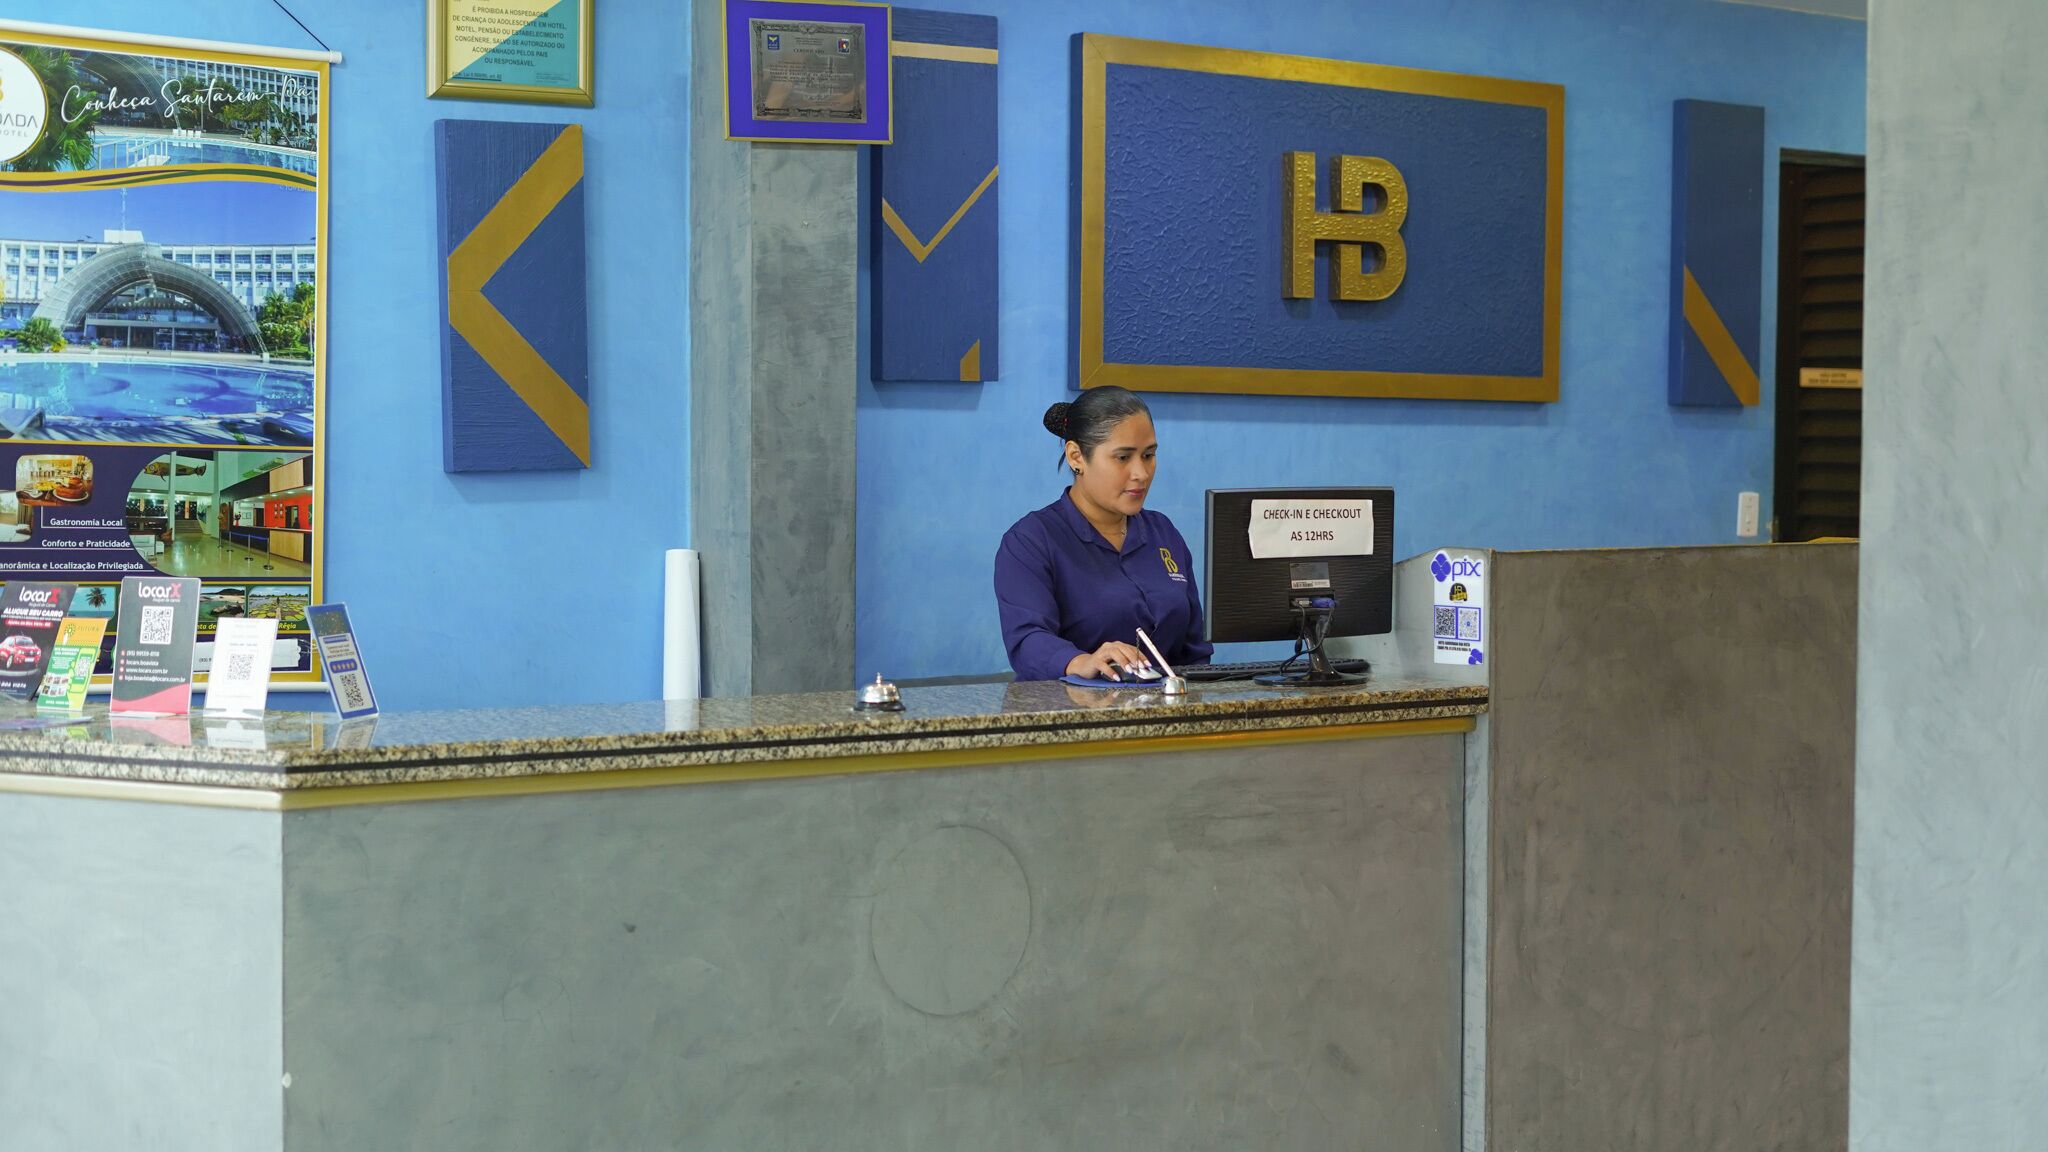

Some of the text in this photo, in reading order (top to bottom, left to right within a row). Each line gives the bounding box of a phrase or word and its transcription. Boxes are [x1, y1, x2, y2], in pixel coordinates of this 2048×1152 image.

[477, 7, 504, 15] PROIBIDA
[509, 10, 549, 18] HOSPEDAGEM
[461, 16, 487, 24] CRIANÇA
[497, 18, 538, 28] ADOLESCENTE
[477, 27, 501, 35] PENSÃO
[511, 29, 565, 39] ESTABELECIMENTO
[520, 40, 556, 49] AUTORIZADO
[472, 47, 516, 56] ACOMPANHADO
[60, 84, 157, 124] Conheça
[0, 112, 38, 128] ADA
[0, 129, 28, 138] OTEL
[1282, 151, 1408, 301] HB
[1263, 508, 1361, 520] CHECK-IN E CHECKOUT
[50, 518, 123, 527] Gastronomia Local
[1290, 531, 1334, 541] AS 12HRS
[41, 540, 77, 548] Conforto
[86, 540, 131, 549] Praticidade
[0, 561, 40, 570] anorâmica
[50, 561, 95, 571] Localização
[97, 561, 144, 571] Privilegiada
[1452, 558, 1481, 582] pix
